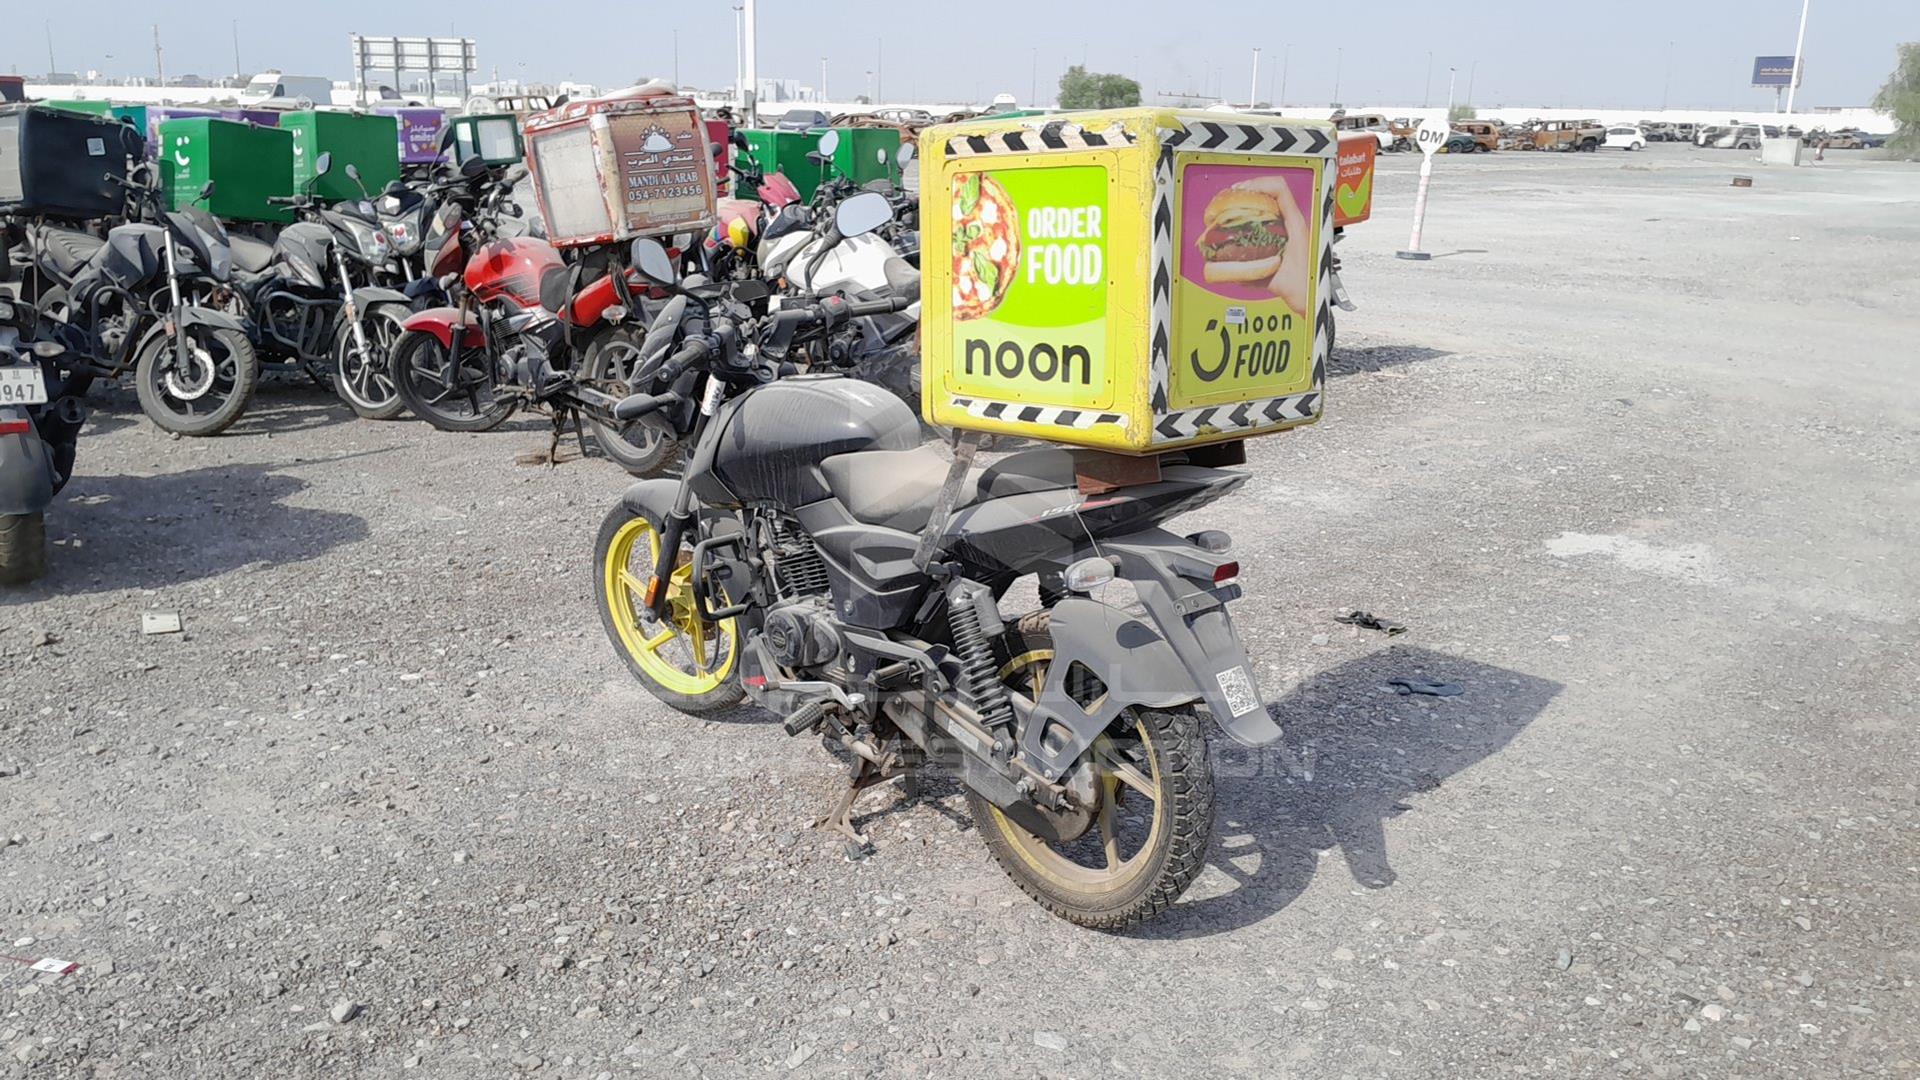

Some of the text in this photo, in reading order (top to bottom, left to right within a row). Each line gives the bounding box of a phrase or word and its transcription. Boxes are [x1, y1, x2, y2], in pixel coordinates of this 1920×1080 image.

[1419, 129, 1444, 145] DM
[629, 171, 699, 187] MANDI AL ARAB
[628, 185, 702, 201] 054-7123456
[1027, 205, 1102, 239] ORDER
[1027, 243, 1103, 286] FOOD
[1238, 314, 1292, 335] noon
[965, 338, 1091, 385] noon
[1233, 340, 1291, 379] FOOD
[0, 384, 35, 402] 947
[1041, 503, 1081, 517] 150
